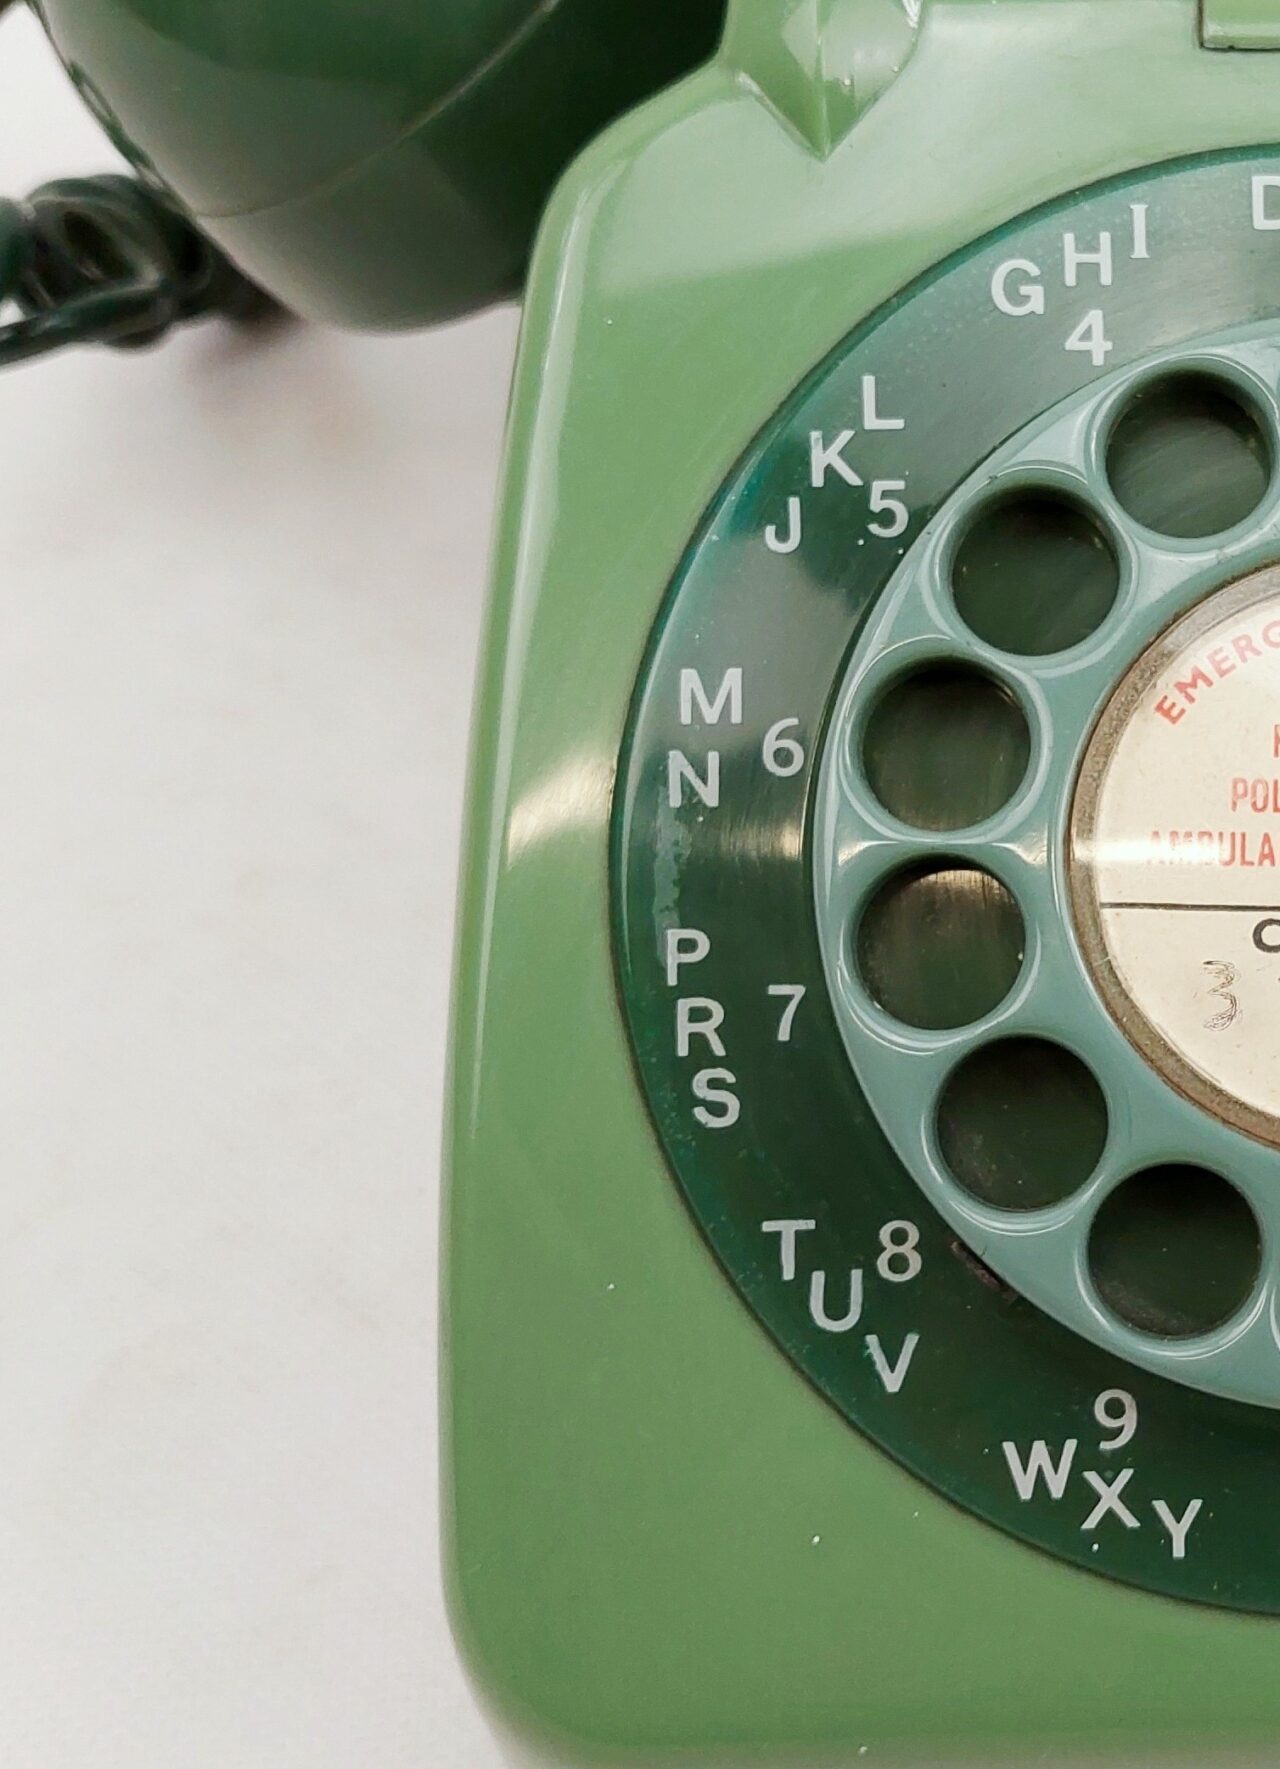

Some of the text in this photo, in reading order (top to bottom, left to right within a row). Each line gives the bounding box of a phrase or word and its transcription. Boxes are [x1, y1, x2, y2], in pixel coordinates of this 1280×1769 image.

[990, 204, 1150, 317] GHI
[1064, 309, 1113, 366] 4
[867, 480, 910, 538] 5
[761, 717, 806, 778] 6
[766, 984, 806, 1042] 7
[876, 1220, 922, 1282] 8
[1094, 1388, 1137, 1451] 9
[1002, 1438, 1202, 1559] WXY
